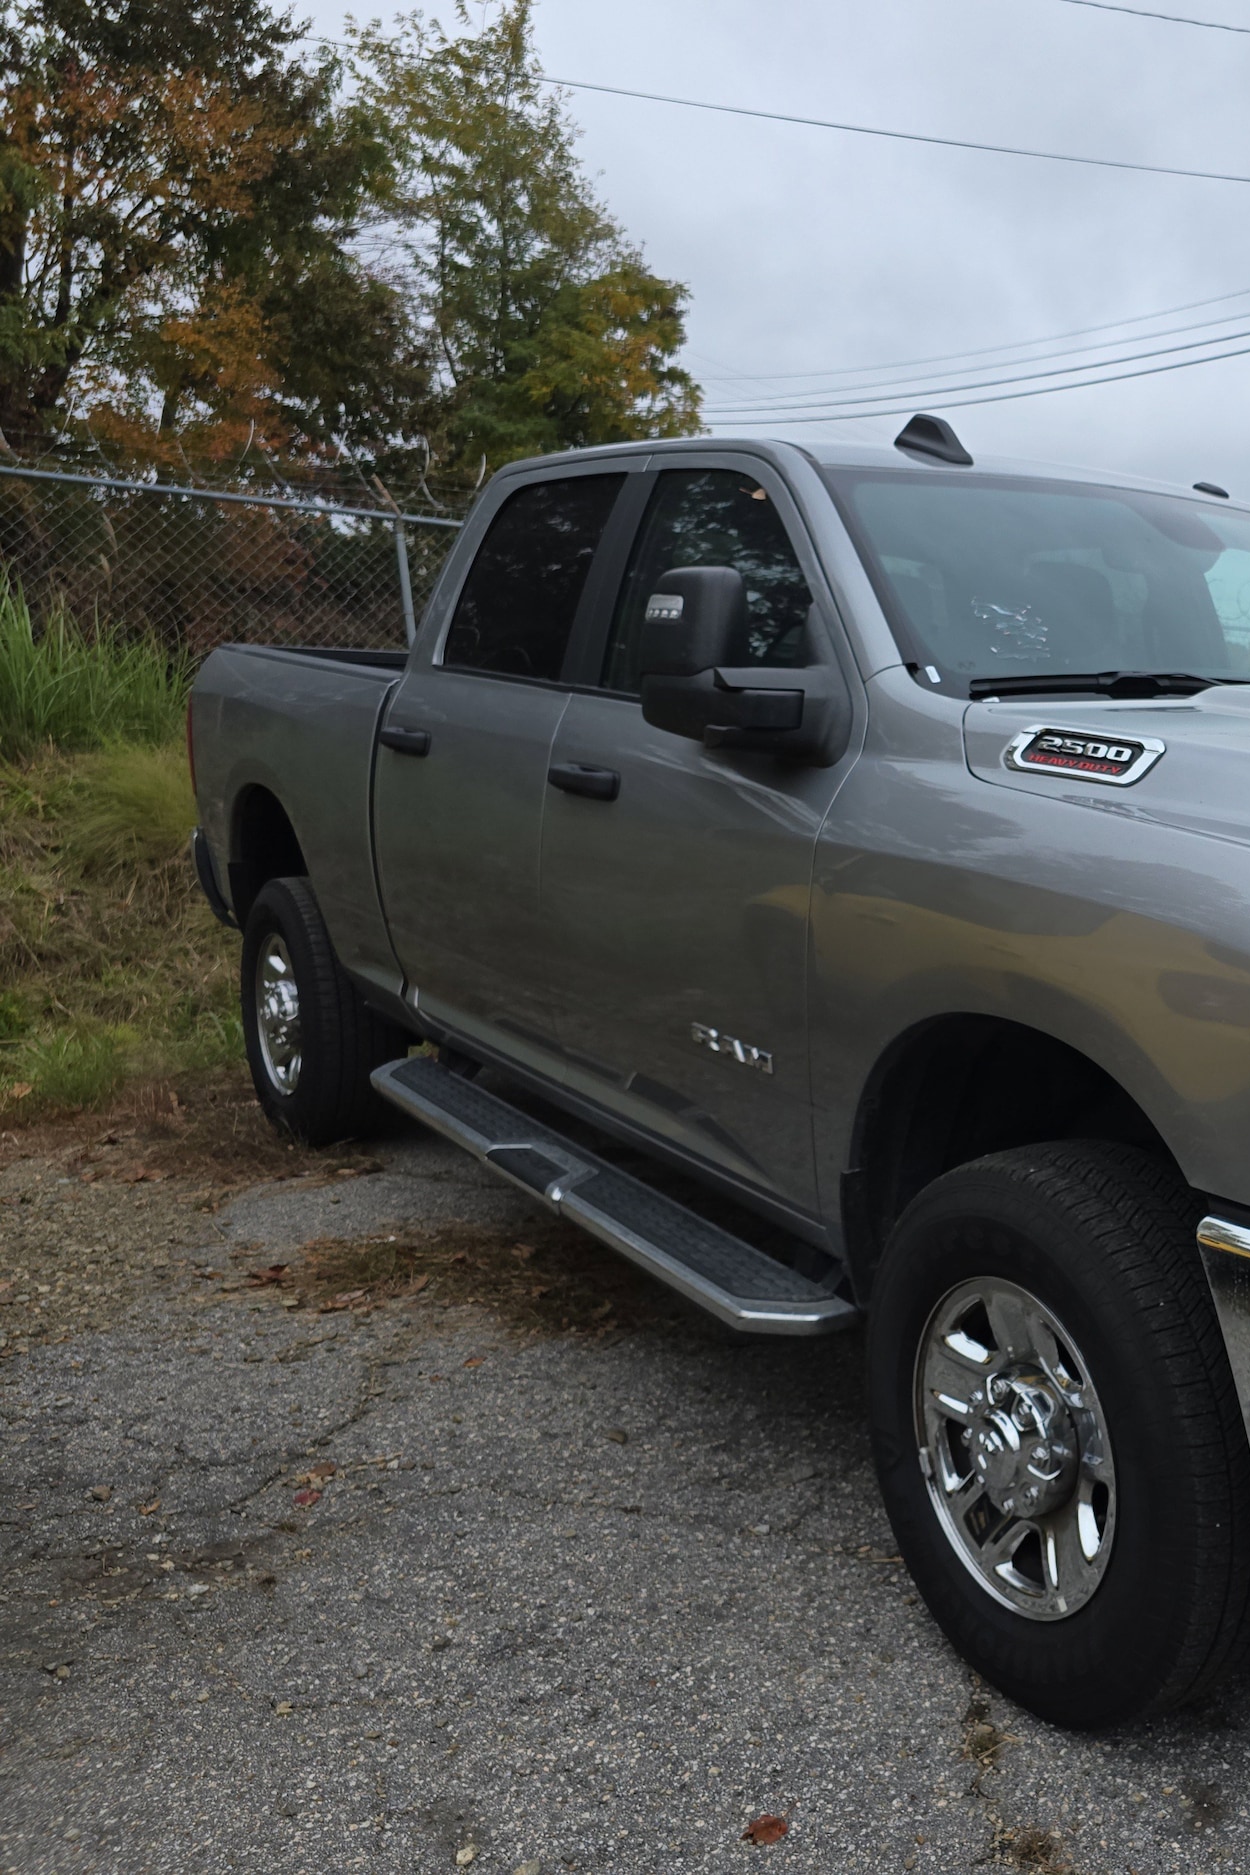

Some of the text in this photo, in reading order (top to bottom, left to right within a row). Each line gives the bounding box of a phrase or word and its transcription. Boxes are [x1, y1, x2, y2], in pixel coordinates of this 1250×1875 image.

[1038, 736, 1132, 761] 2500
[1028, 753, 1122, 774] HEAVY DUTY
